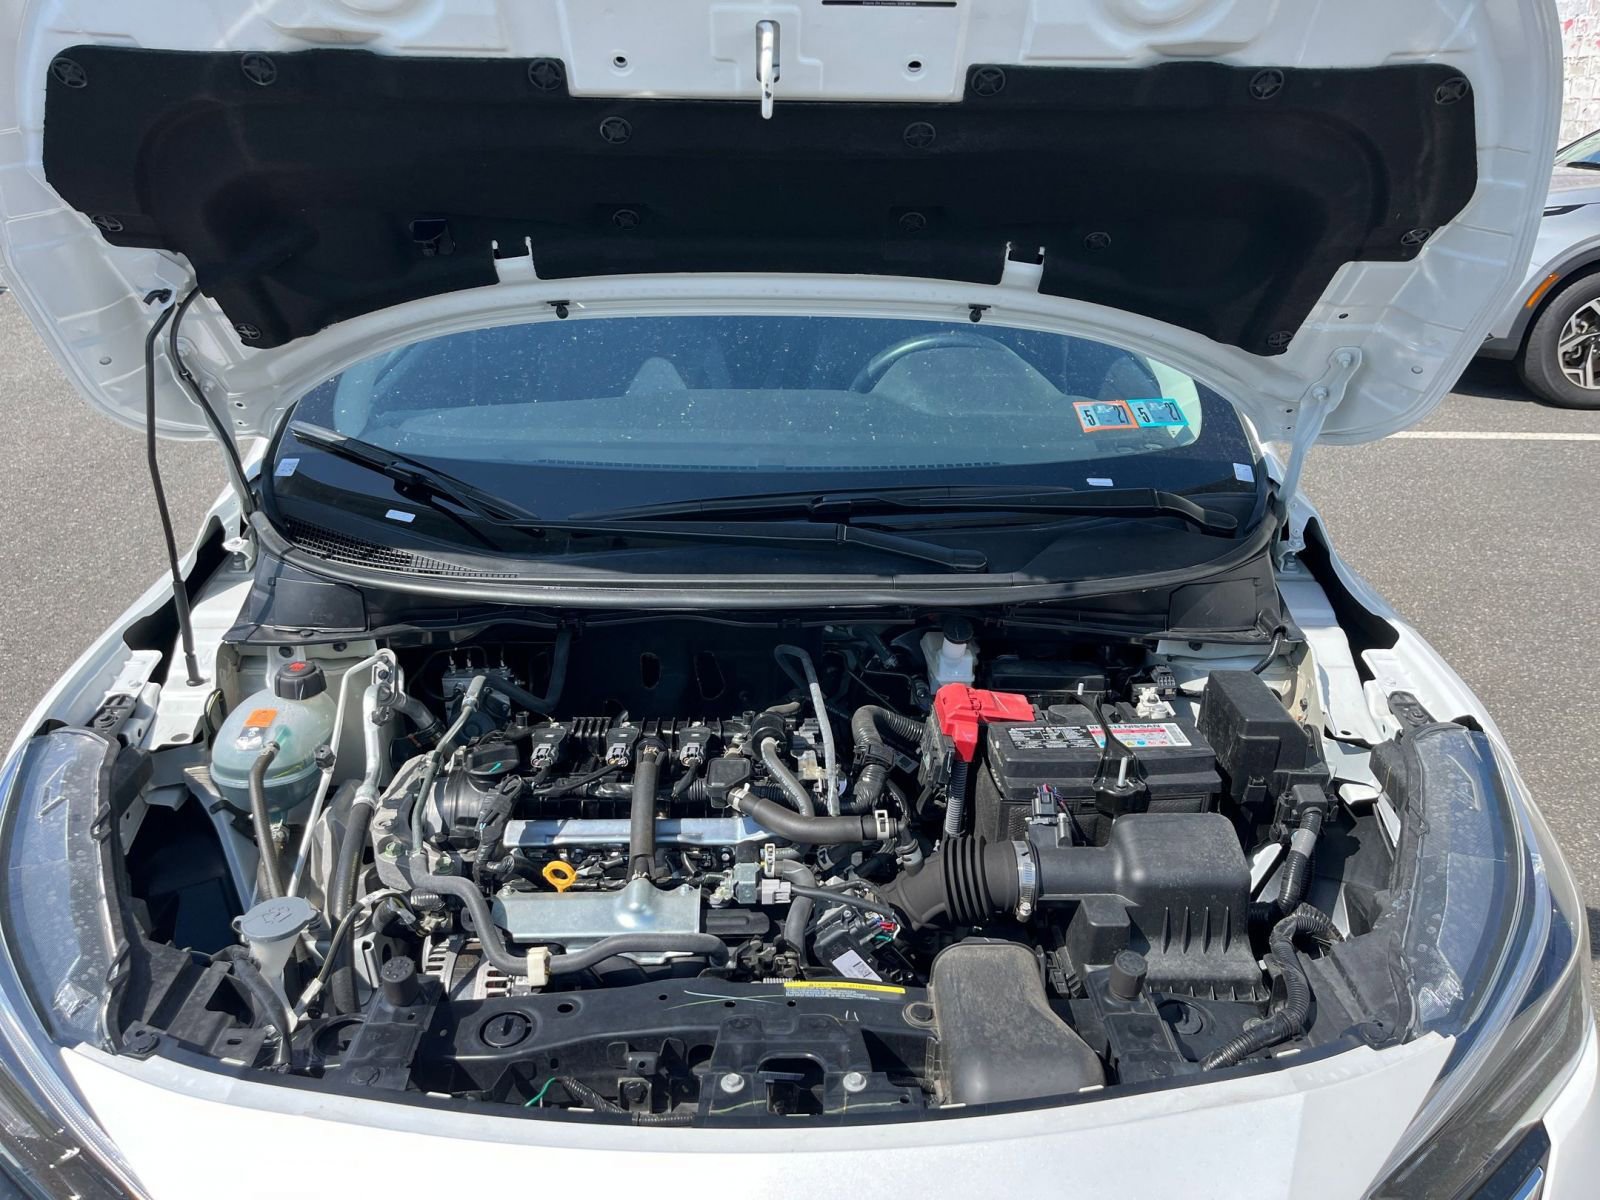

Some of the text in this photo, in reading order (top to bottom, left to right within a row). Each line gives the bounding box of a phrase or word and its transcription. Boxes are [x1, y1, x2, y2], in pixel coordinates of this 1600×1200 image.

[1083, 404, 1130, 426] 5 27
[1137, 402, 1181, 423] 5 27
